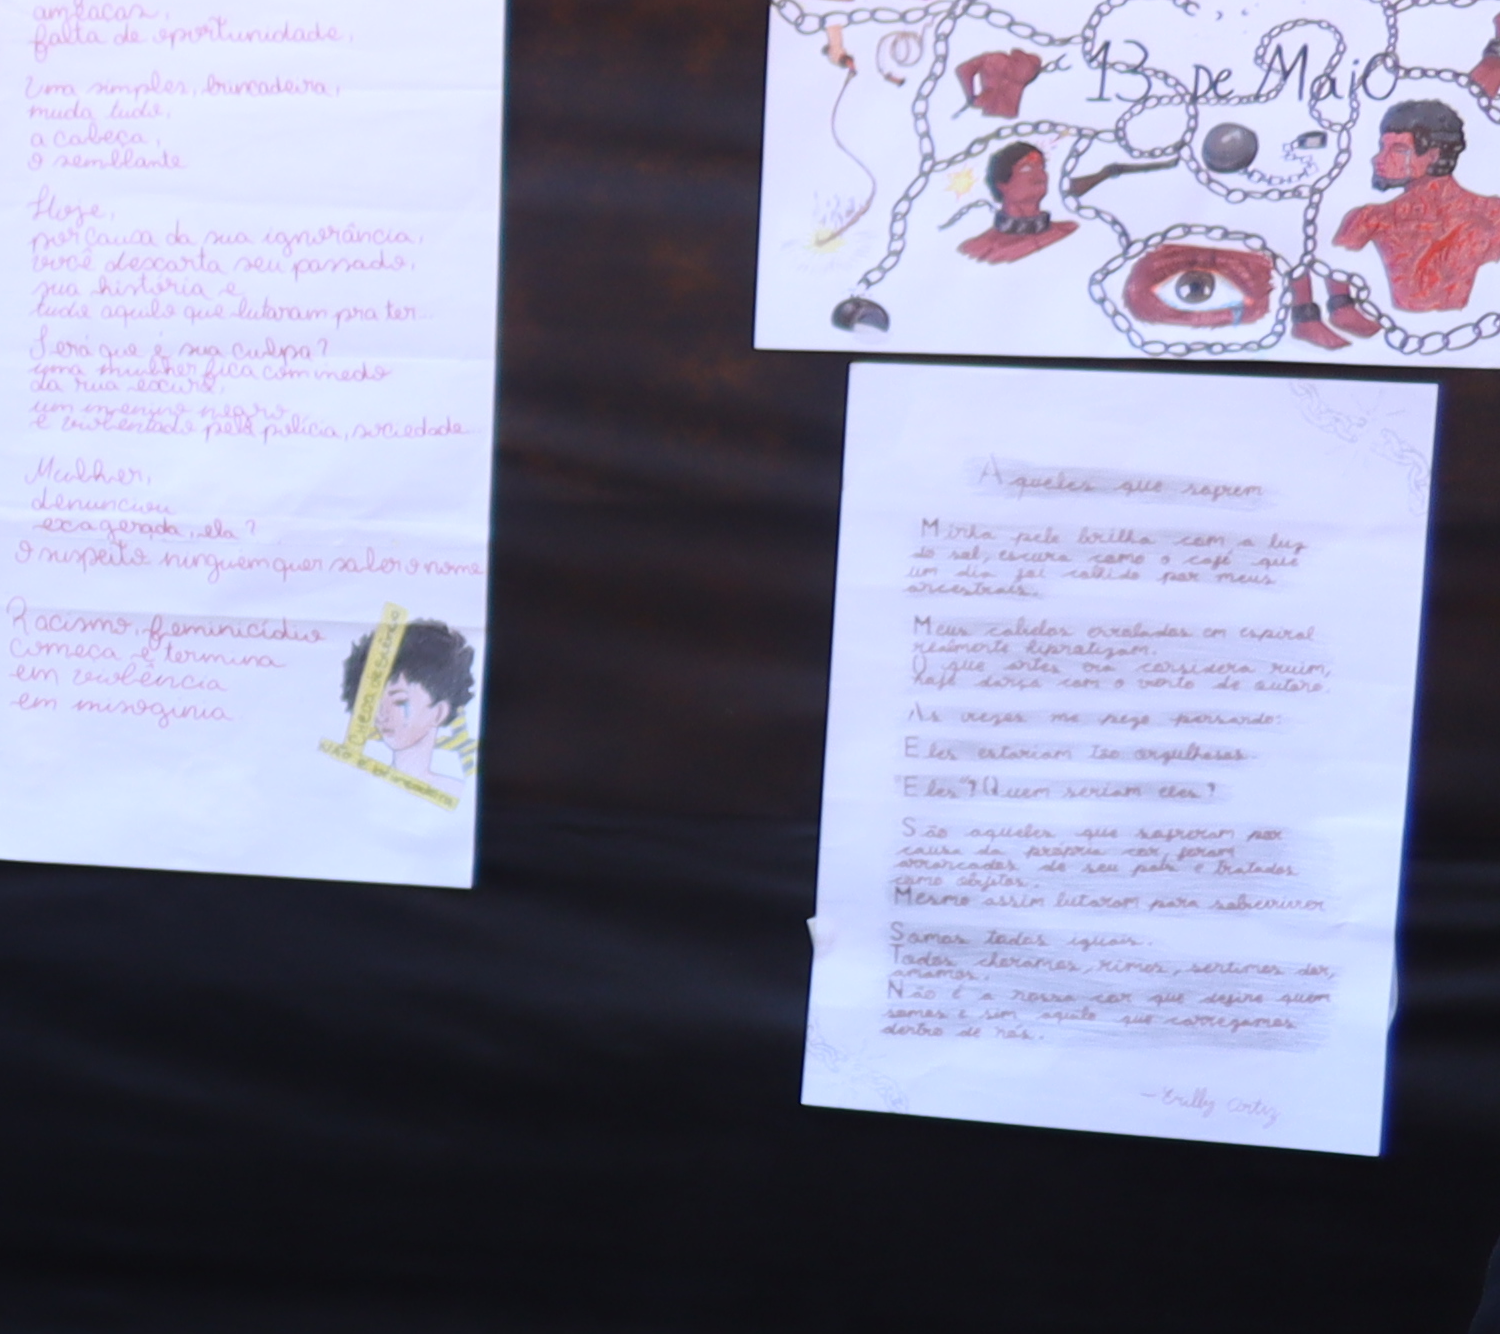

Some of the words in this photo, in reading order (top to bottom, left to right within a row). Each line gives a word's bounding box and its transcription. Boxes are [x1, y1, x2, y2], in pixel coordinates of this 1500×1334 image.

[112, 22, 144, 46] de
[1086, 38, 1152, 102] 13
[28, 96, 94, 119] muda
[30, 131, 47, 148] a
[52, 149, 186, 170] semblante
[165, 218, 197, 246] da
[203, 228, 254, 246] sua
[232, 254, 283, 273] seu
[31, 278, 80, 301] sua
[219, 280, 244, 298] e
[33, 302, 90, 320] tudo
[184, 301, 226, 327] que
[334, 303, 377, 331] pra
[99, 342, 138, 367] que
[177, 342, 224, 359] sua
[1011, 526, 1060, 546] pele
[1077, 525, 1157, 545] brilha
[165, 641, 288, 668] termina
[11, 665, 60, 685] em
[10, 692, 60, 712] em
